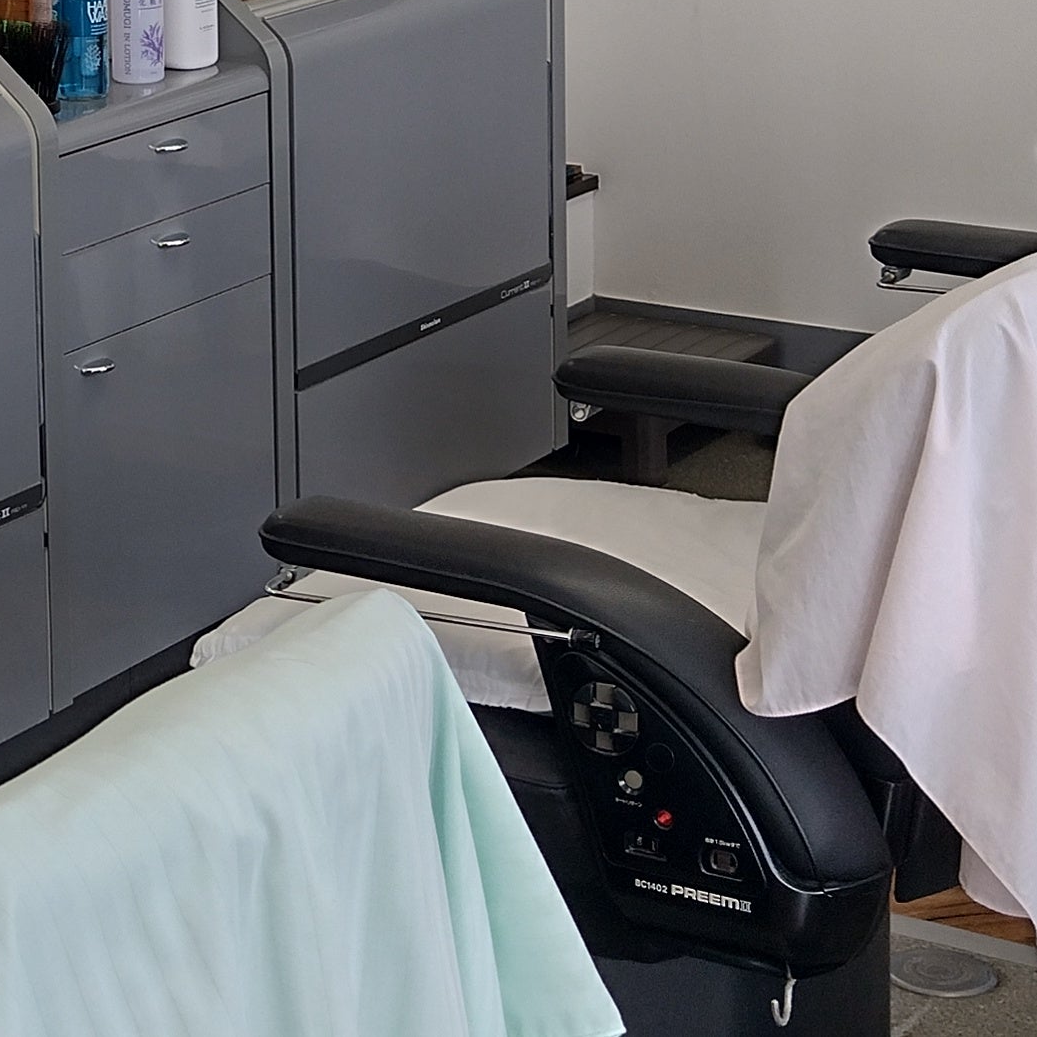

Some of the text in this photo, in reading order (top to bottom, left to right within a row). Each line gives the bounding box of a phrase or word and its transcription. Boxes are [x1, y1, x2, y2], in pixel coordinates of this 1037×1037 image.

[124, 32, 131, 42] IN
[124, 44, 132, 76] LOTION
[634, 878, 669, 895] BC1402
